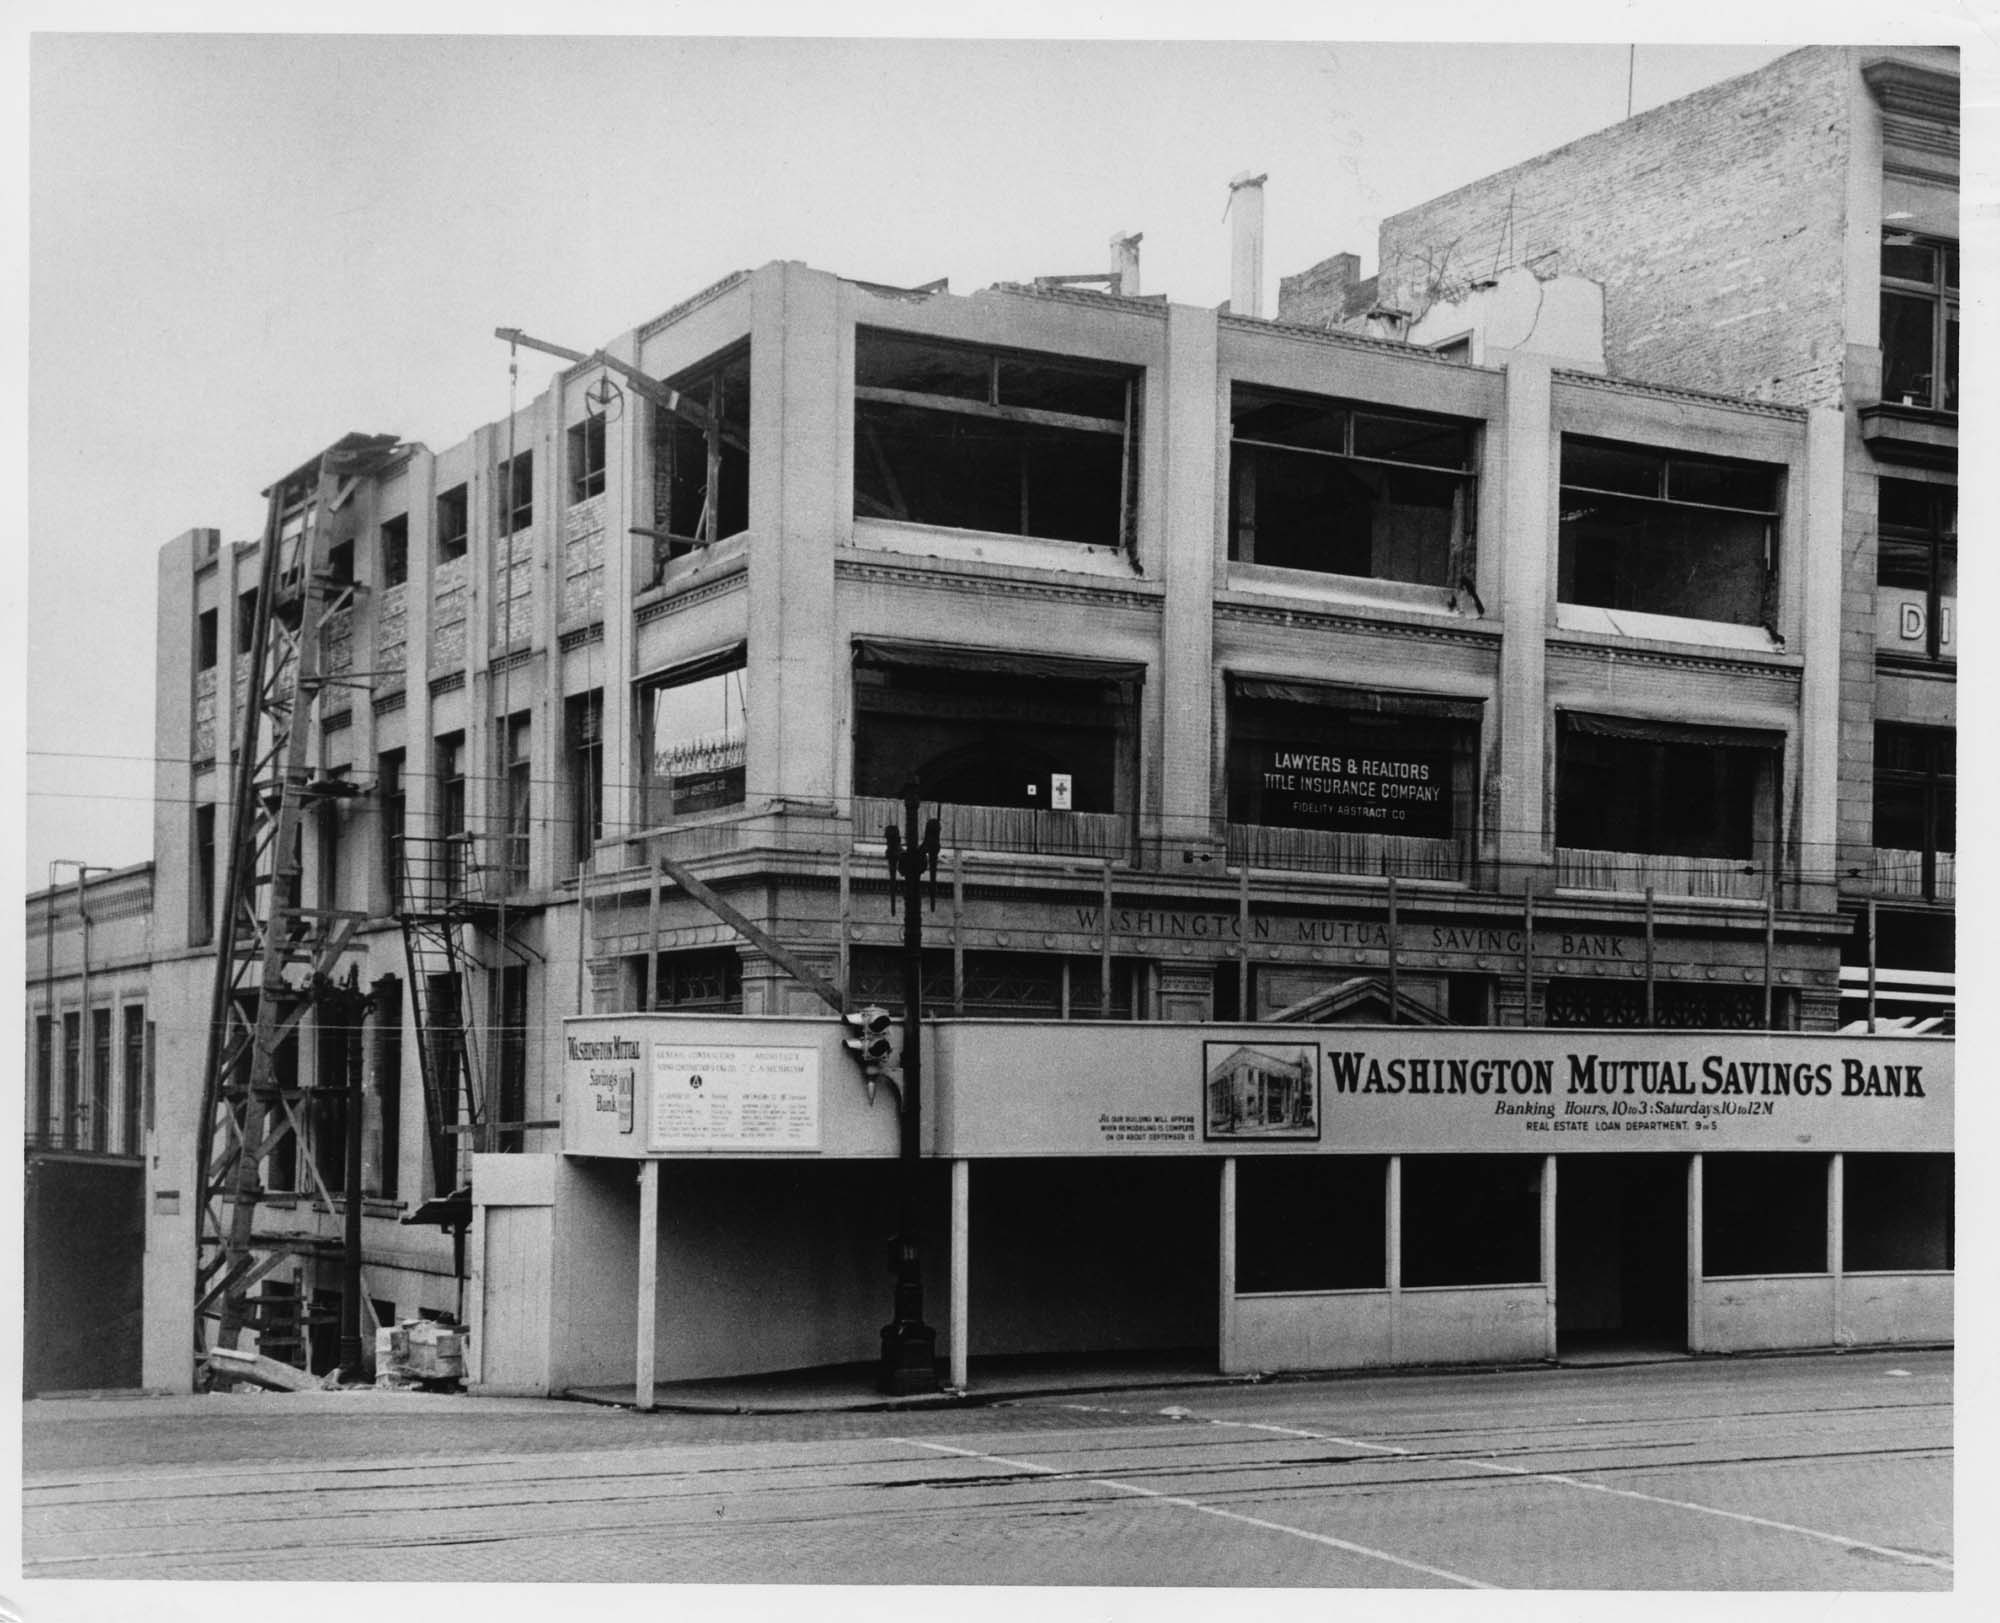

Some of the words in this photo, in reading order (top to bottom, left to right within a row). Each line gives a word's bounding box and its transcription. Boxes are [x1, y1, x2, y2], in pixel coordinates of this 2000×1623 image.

[1275, 752, 1341, 773] LAWYERS
[1347, 758, 1358, 774] &
[1362, 760, 1429, 780] REALTORS
[1264, 773, 1295, 790] TITLE
[1301, 777, 1376, 797] INSURANCE
[1381, 783, 1440, 801] COMPANY
[1293, 801, 1333, 814] FIDELITY
[1337, 805, 1387, 818] ABSTRACT
[1298, 921, 1402, 945] MUTUA
[1432, 927, 1535, 951] SAVING
[1562, 935, 1623, 957] BANK
[1328, 1051, 1554, 1094] WASHINGTON
[1567, 1054, 1696, 1095] MUTUAL
[1701, 1056, 1832, 1096] SAVINGS
[1841, 1058, 1926, 1098] BANK
[1494, 1100, 1556, 1119] Banking
[1526, 1121, 1550, 1131] REAL
[1553, 1121, 1588, 1131] ESTATE
[1595, 1121, 1620, 1131] LOAN
